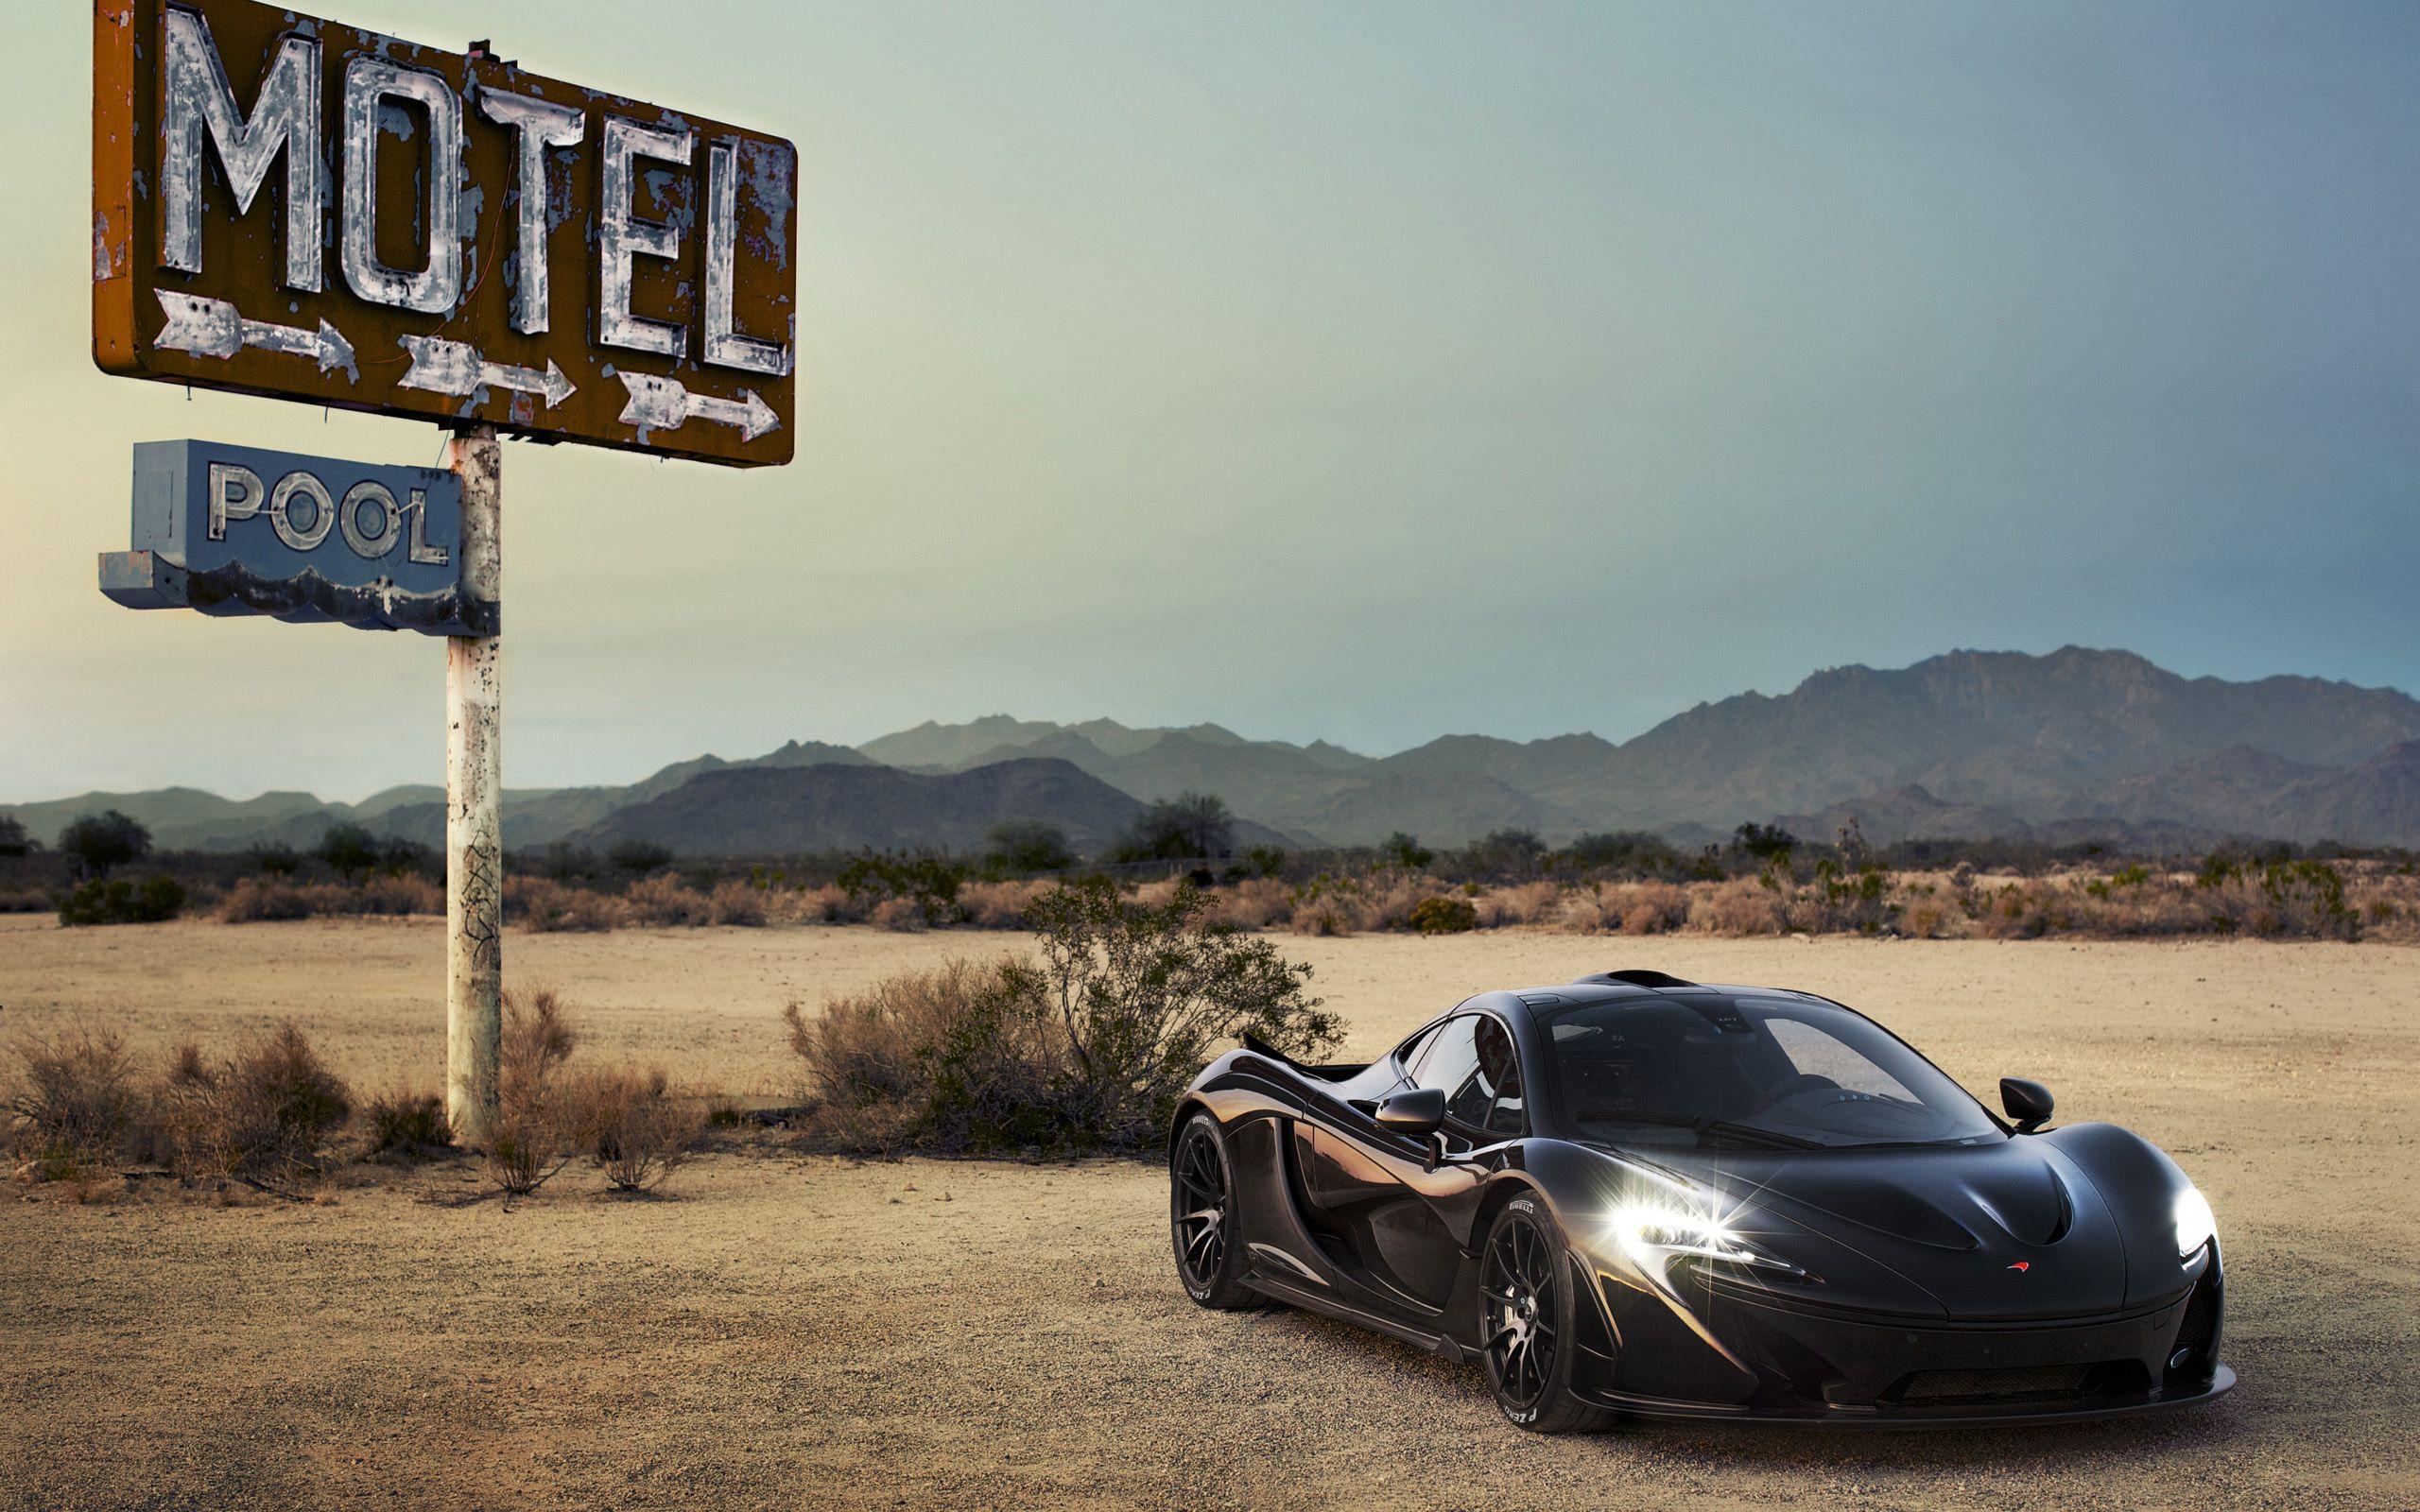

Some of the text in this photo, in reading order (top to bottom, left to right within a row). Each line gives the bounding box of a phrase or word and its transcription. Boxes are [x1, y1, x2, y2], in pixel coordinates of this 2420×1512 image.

[161, 7, 786, 376] MOTEL
[207, 460, 449, 566] POOL
[1509, 1199, 1533, 1214] PIRELLI
[1205, 1288, 1211, 1299] P
[1504, 1405, 1537, 1423] P ZERO
